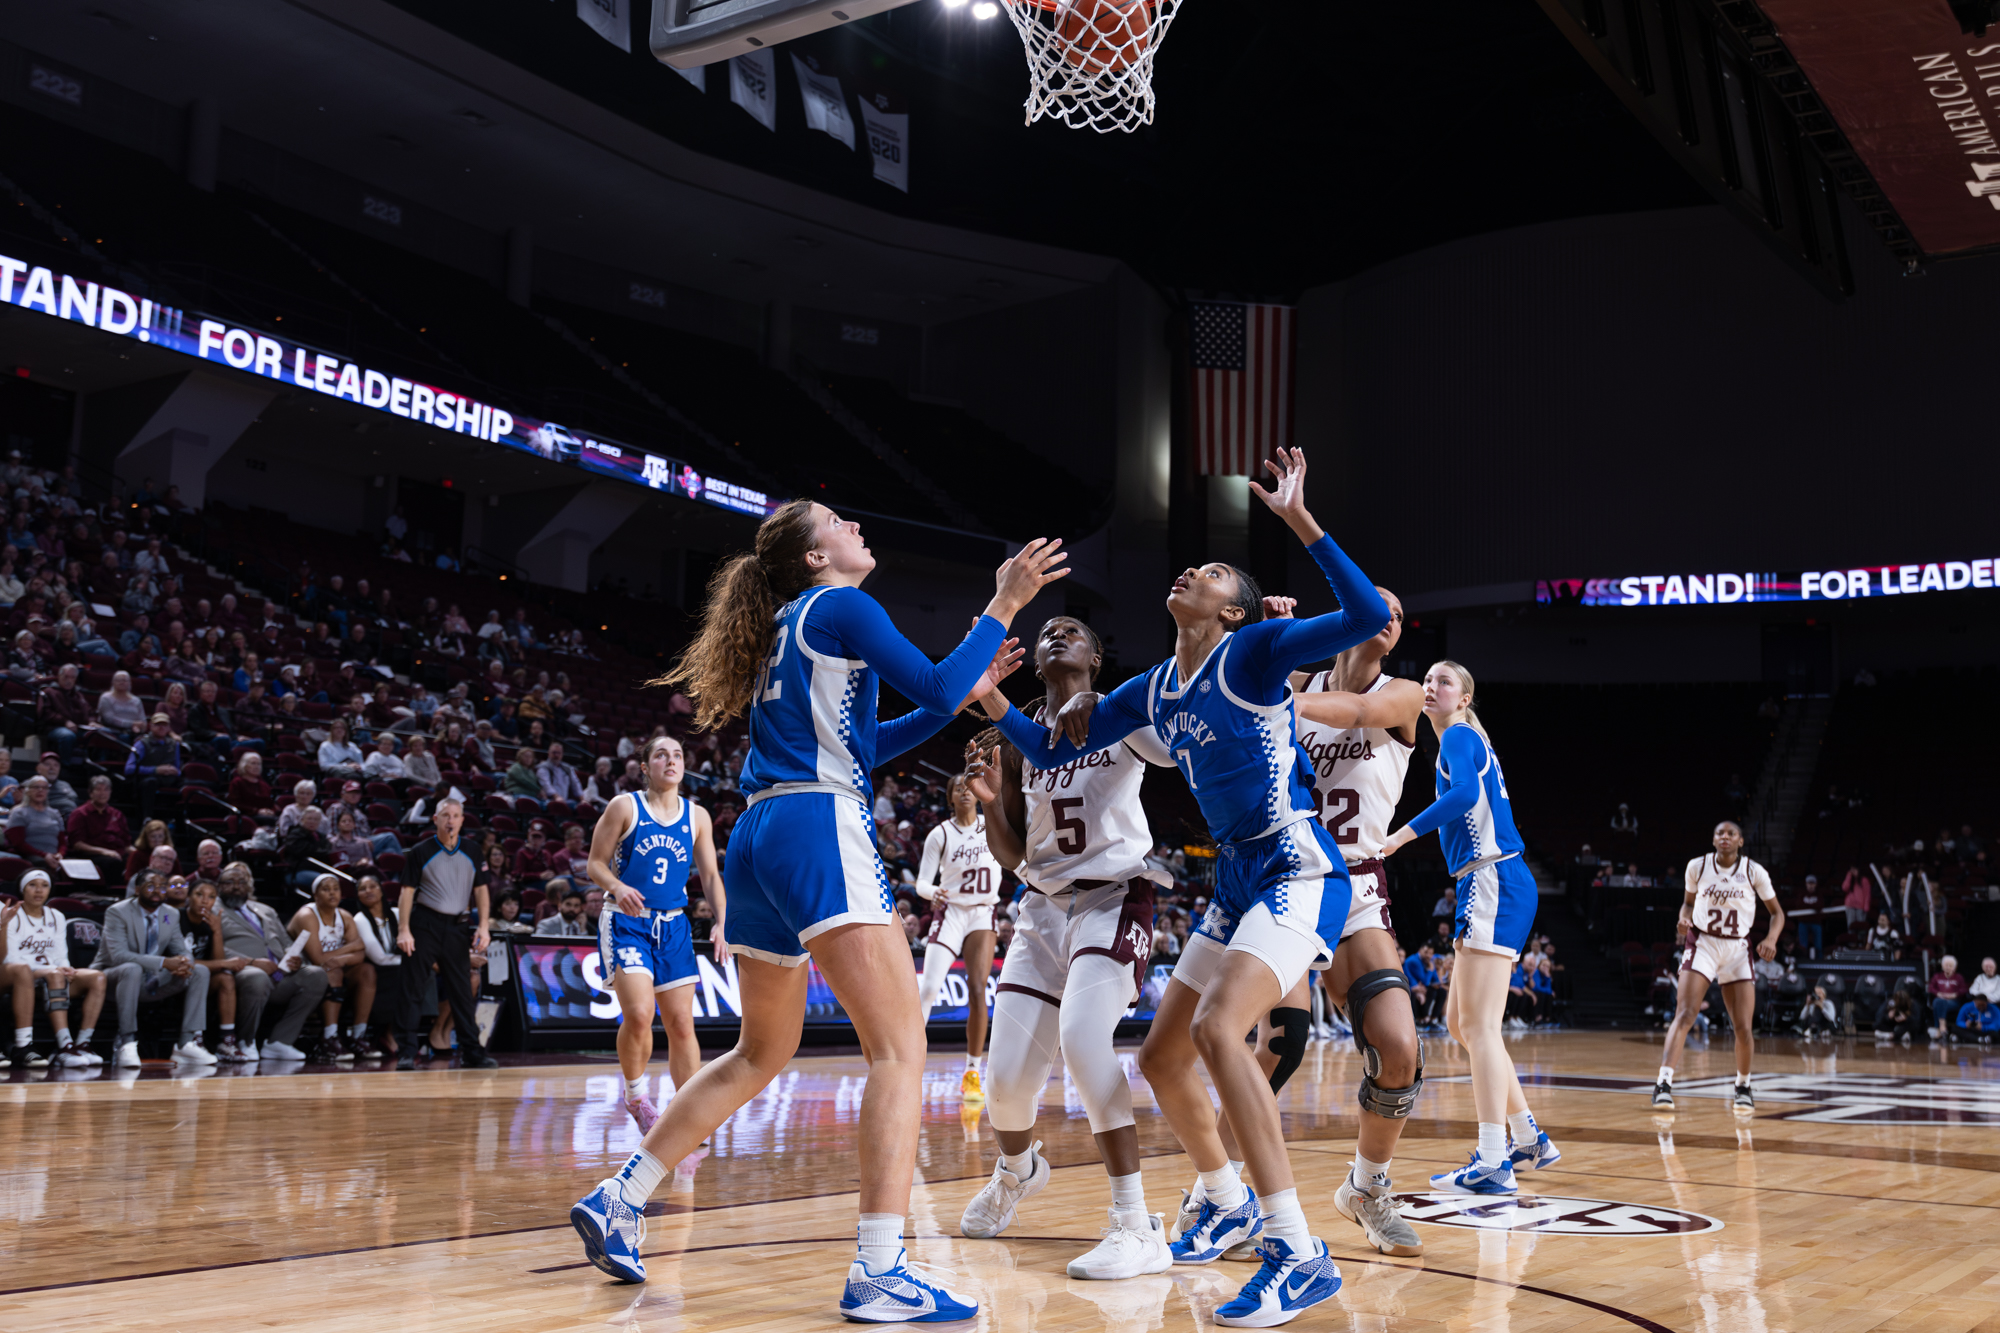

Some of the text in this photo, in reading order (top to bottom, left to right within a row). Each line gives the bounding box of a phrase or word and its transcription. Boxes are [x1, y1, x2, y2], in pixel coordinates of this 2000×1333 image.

[29, 67, 83, 105] 222
[1912, 52, 2000, 155] AMERICAN
[363, 195, 402, 225] 223
[629, 281, 667, 309] 224
[841, 324, 878, 346] 225
[198, 319, 283, 379] FOR
[294, 347, 514, 444] LEADERSHIP
[705, 477, 767, 506] BEST IN TEXAS
[1620, 558, 2000, 606] STAND! FOR LEADE
[1176, 749, 1198, 789] 7
[1296, 731, 1376, 778] Aggies
[1051, 797, 1086, 855] 5
[634, 834, 688, 863] KENTUCKY
[652, 857, 669, 885] 3
[959, 867, 991, 894] 20
[1702, 884, 1745, 906] Aggies
[1707, 909, 1739, 935] 24
